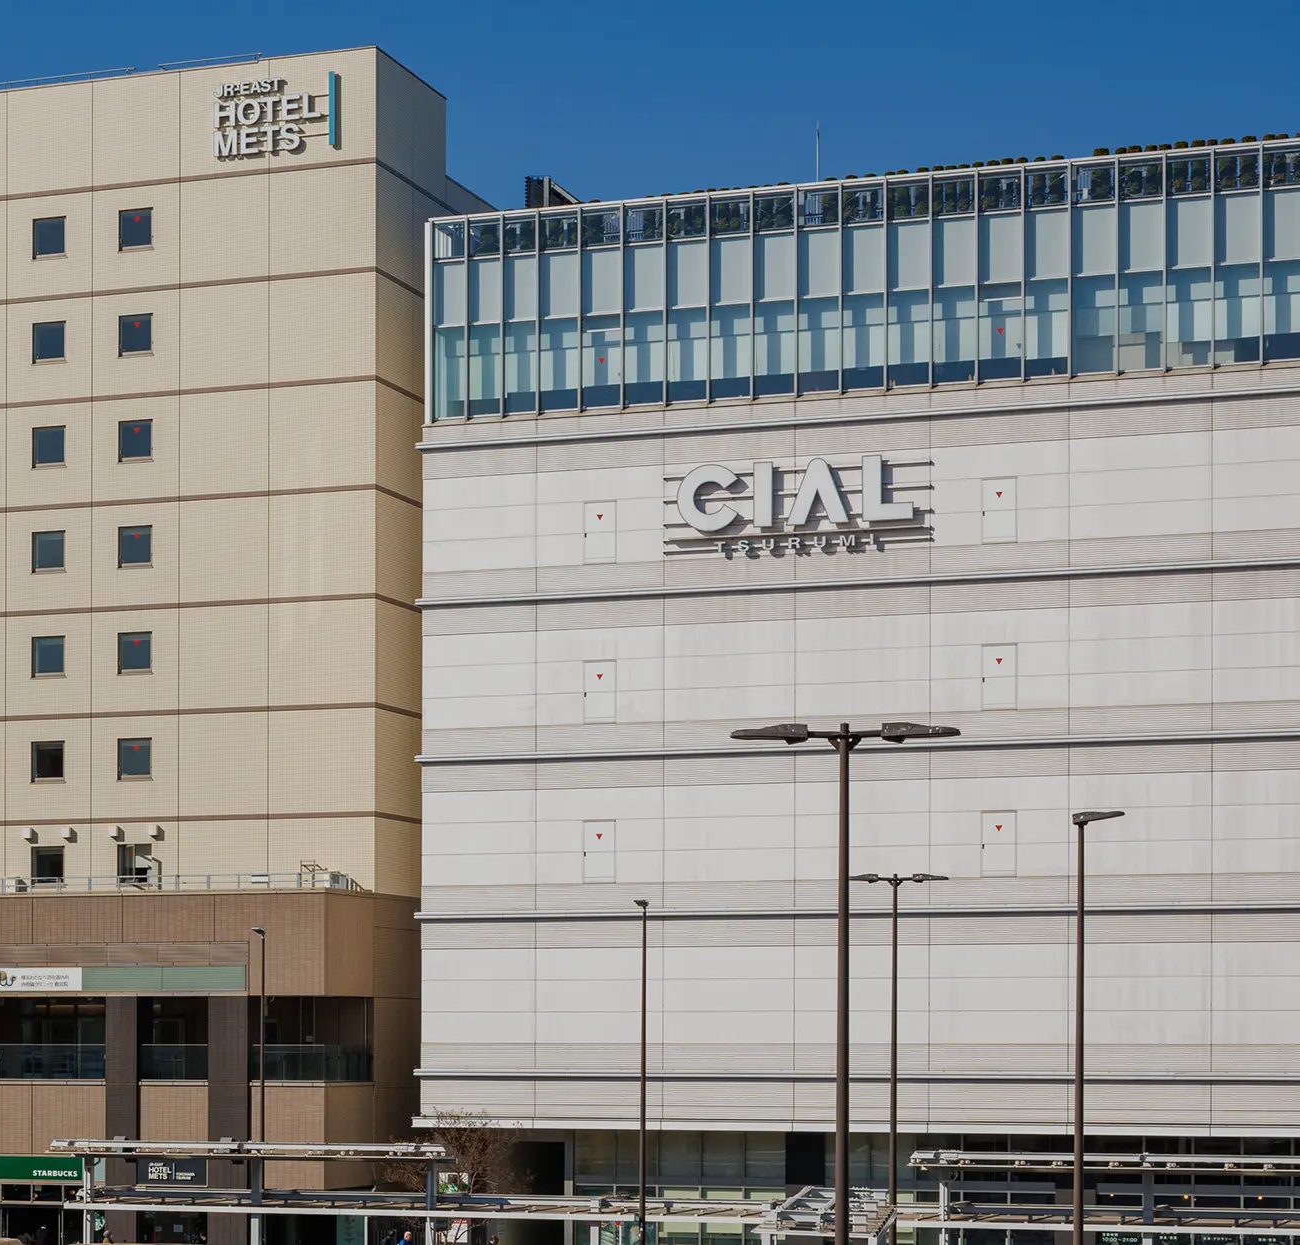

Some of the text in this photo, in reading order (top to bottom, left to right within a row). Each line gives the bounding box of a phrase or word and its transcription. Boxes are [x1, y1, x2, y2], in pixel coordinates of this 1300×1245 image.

[214, 77, 282, 98] JR-EAST
[213, 92, 321, 128] HOTEL
[213, 123, 300, 157] METS
[676, 454, 914, 532] CIAL
[714, 533, 876, 553] TSURUMI
[32, 1169, 78, 1177] STARBUCKS
[148, 1166, 172, 1174] HOTEL
